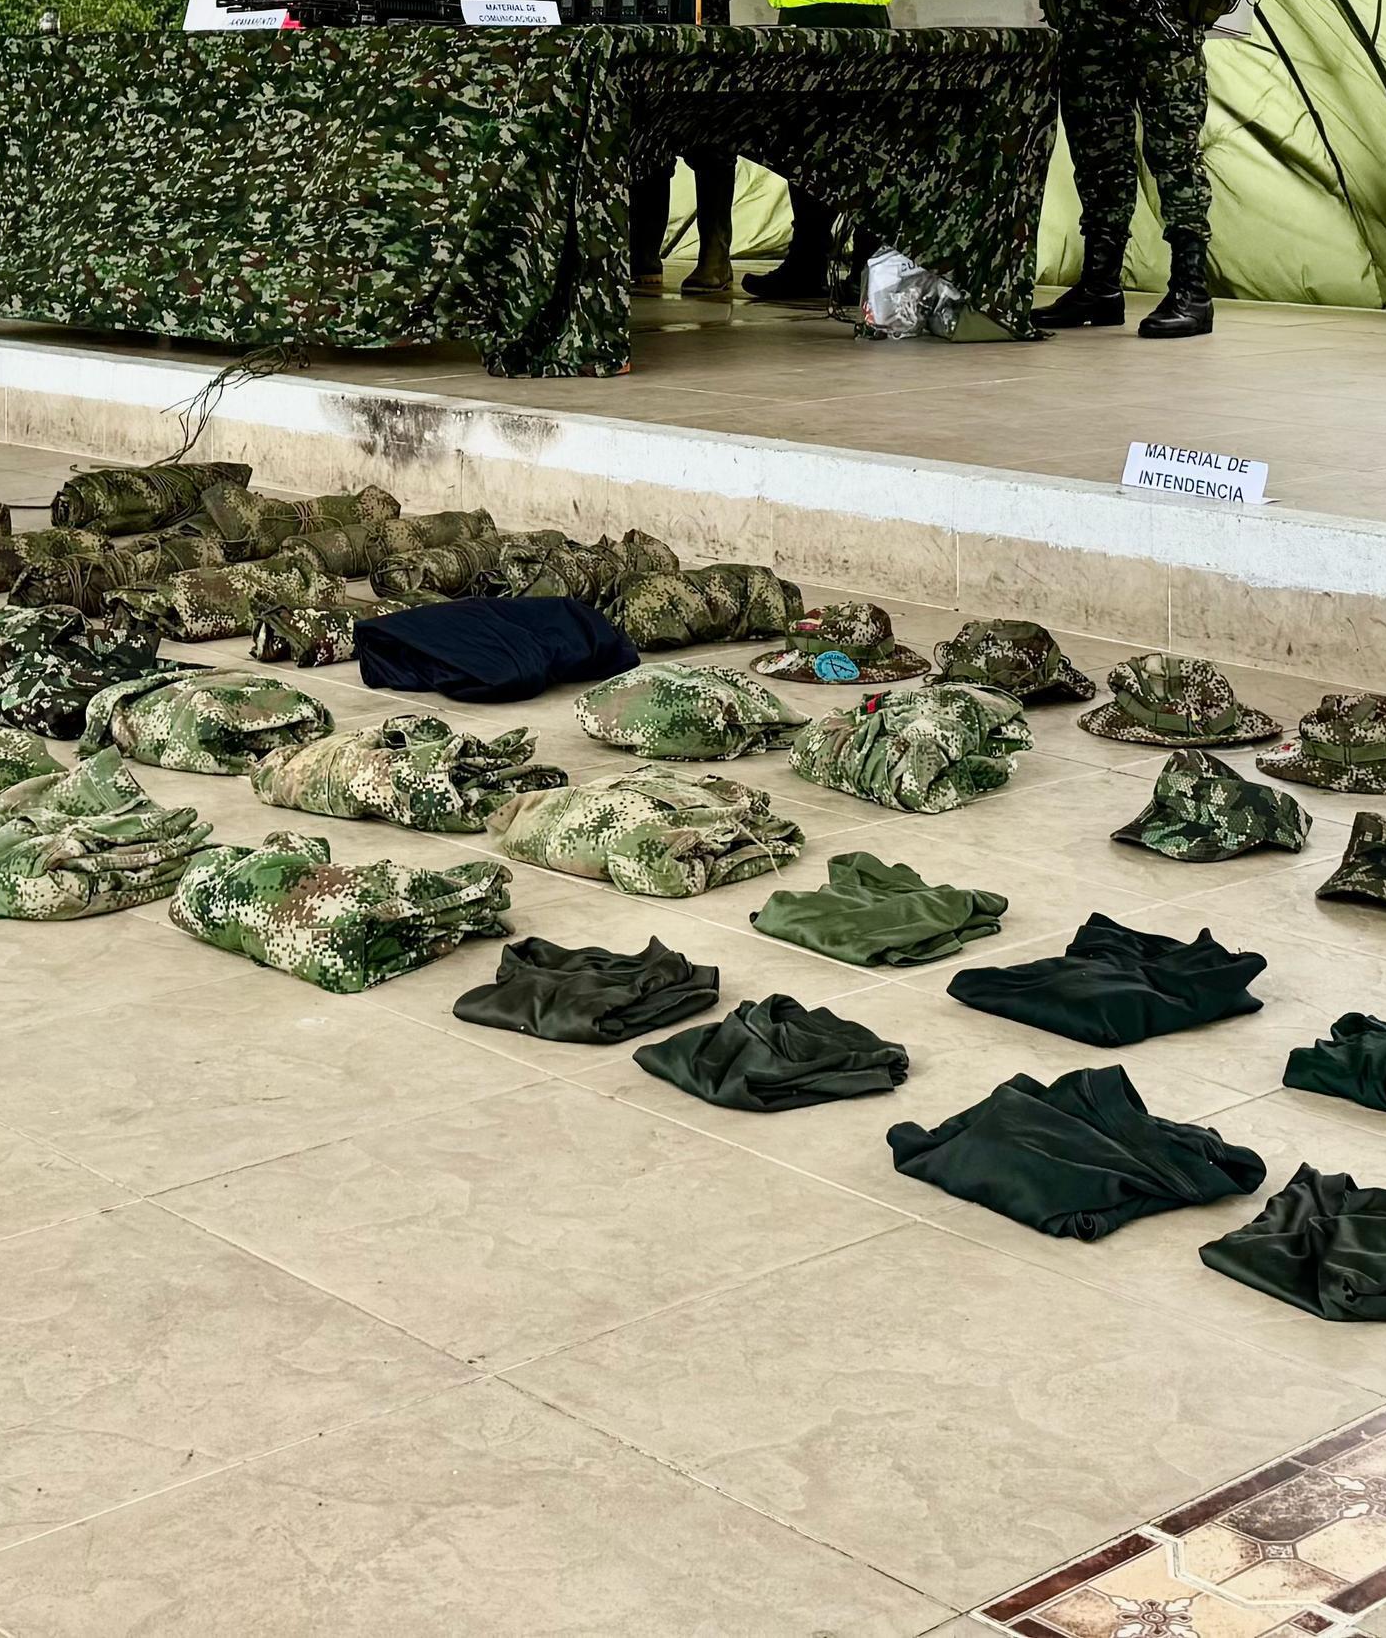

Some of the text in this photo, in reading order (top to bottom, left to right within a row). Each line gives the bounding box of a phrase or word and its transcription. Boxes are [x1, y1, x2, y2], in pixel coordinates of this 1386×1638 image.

[485, 3, 536, 12] MATERIAL DE
[1144, 443, 1251, 474] MATERIAL DE
[1138, 469, 1245, 503] INTENDENCIA
